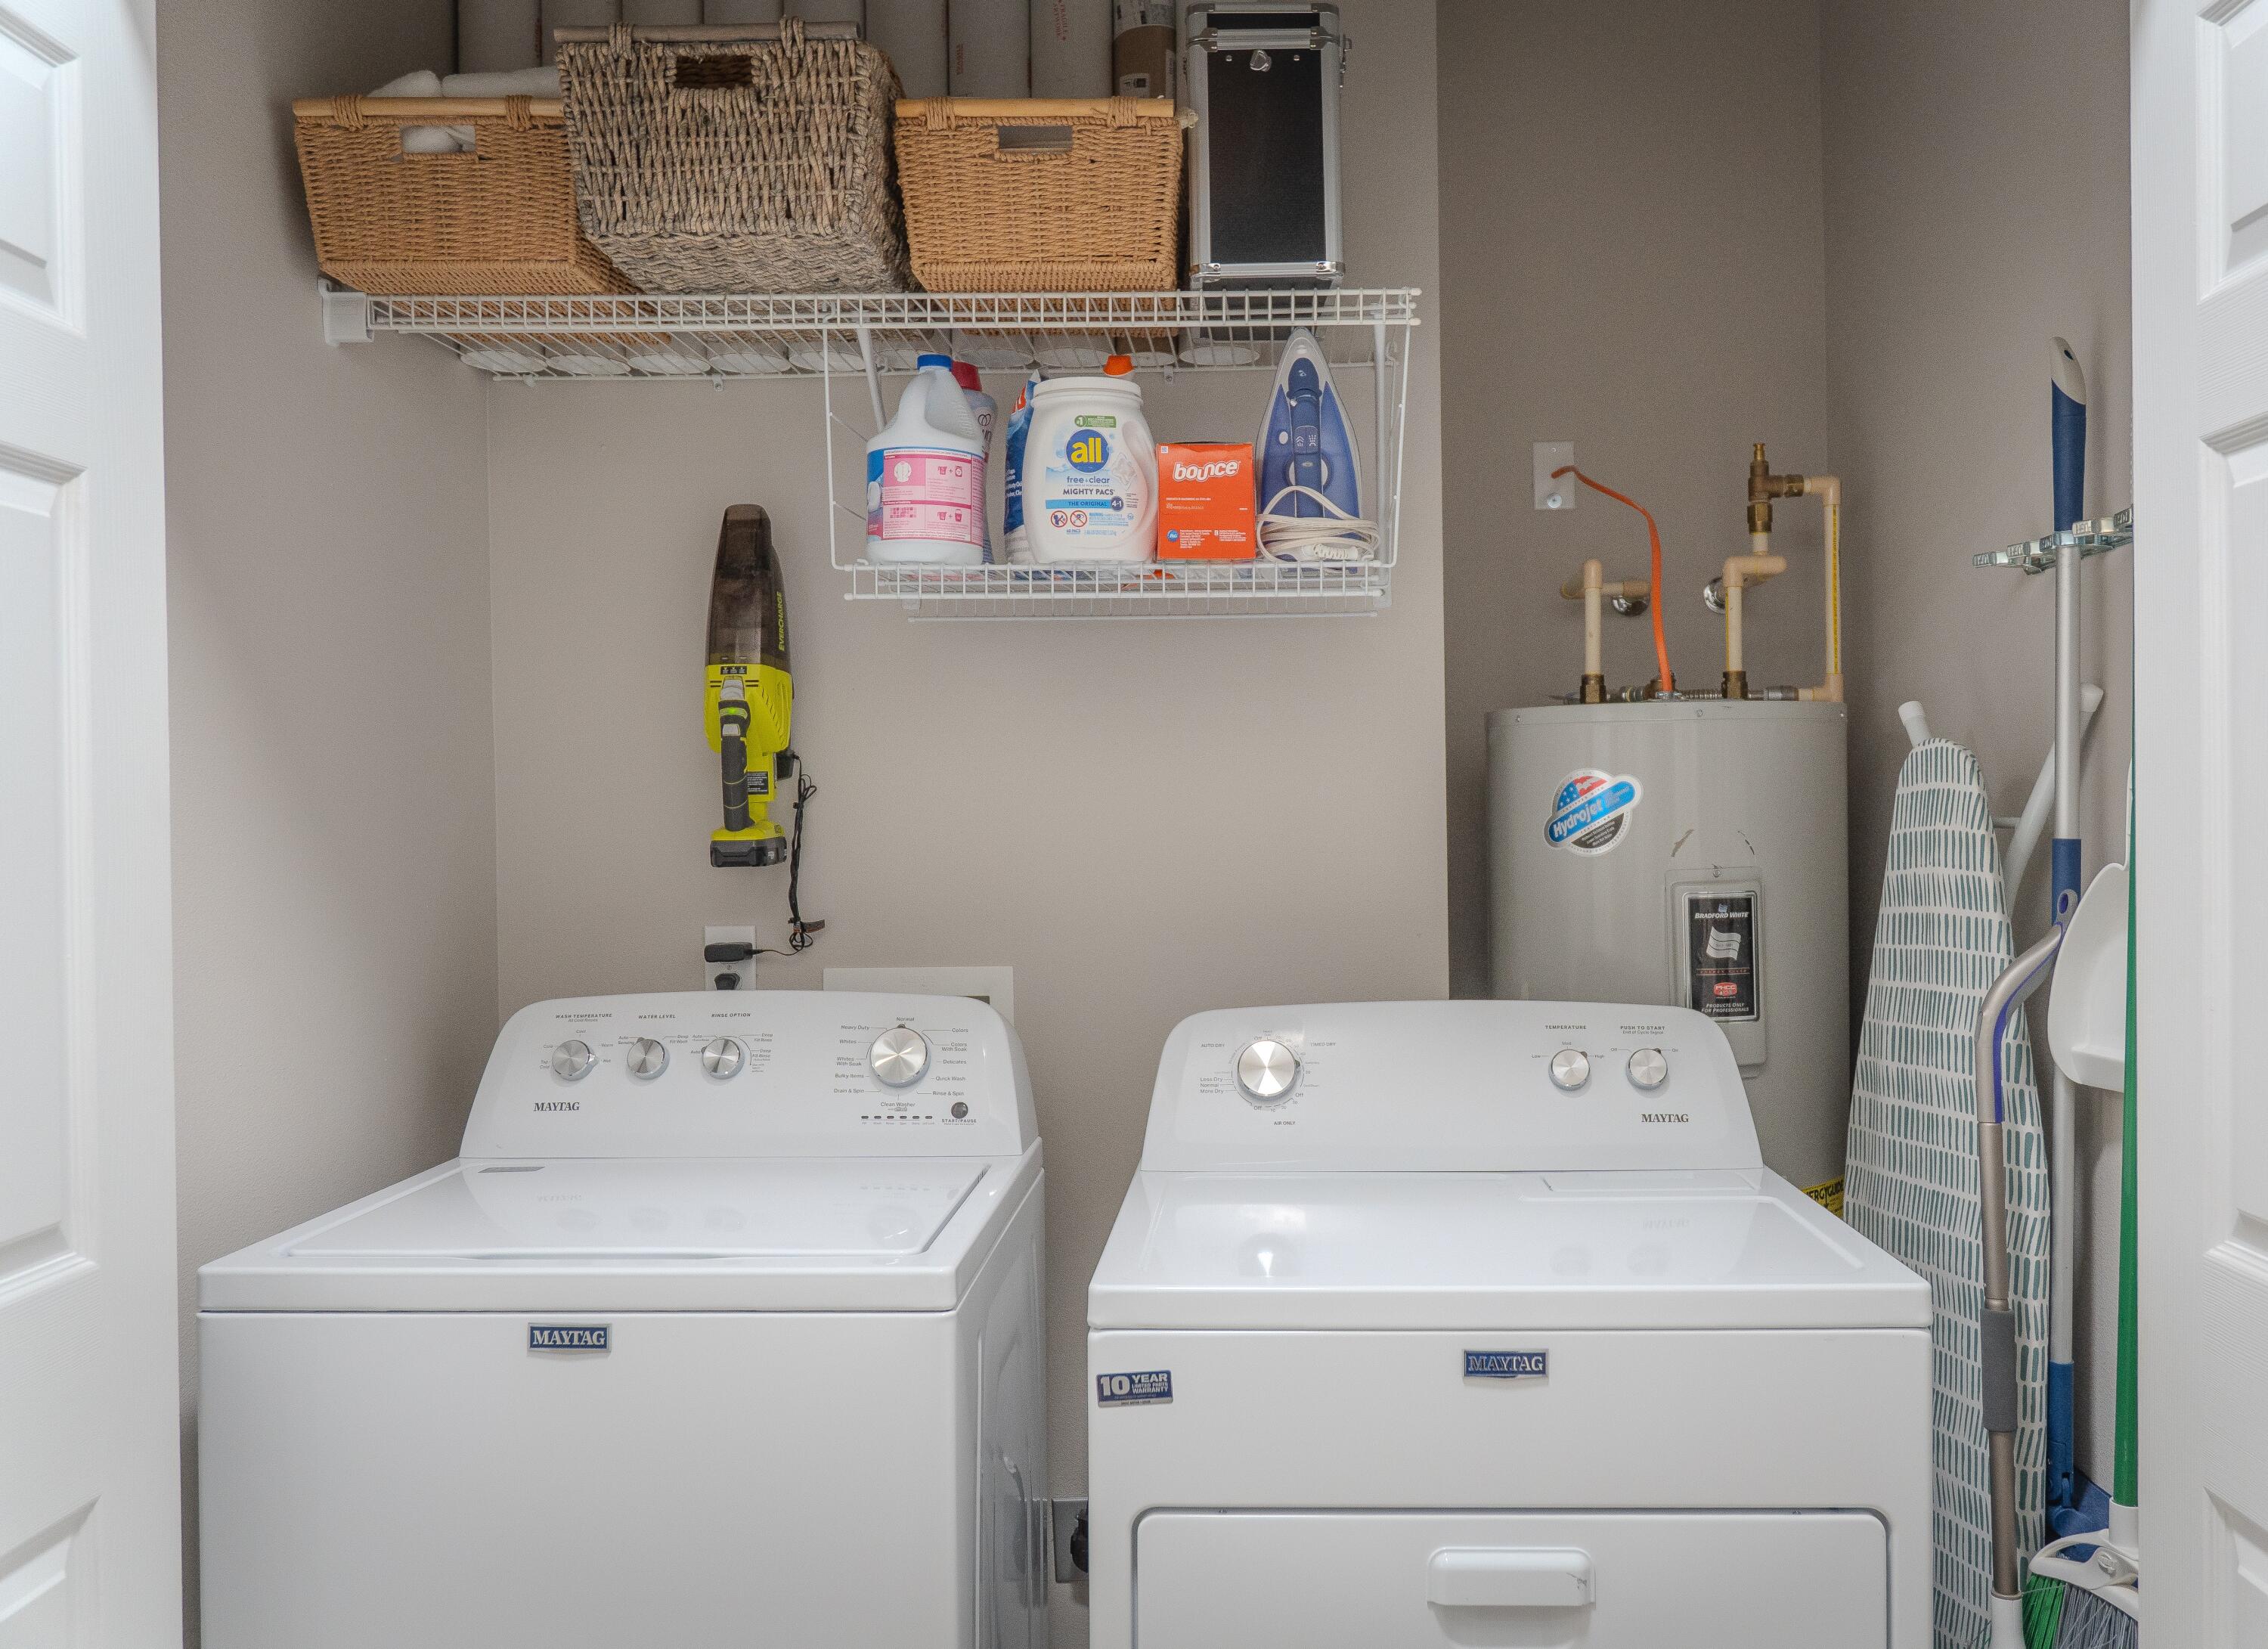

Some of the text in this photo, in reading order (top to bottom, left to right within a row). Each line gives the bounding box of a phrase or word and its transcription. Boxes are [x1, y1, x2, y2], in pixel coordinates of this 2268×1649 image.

[1071, 437, 1102, 463] all
[1173, 460, 1238, 482] bounce
[776, 591, 785, 651] EVERCHARGE
[1553, 798, 1603, 838] Hydrojet
[534, 1102, 581, 1111] MAYTAG
[1641, 1114, 1689, 1123] MAYTAG
[532, 1330, 606, 1345] MAYTAG
[1467, 1356, 1544, 1372] MAYTAG
[1100, 1375, 1130, 1396] 10
[1131, 1373, 1168, 1384] YEAR
